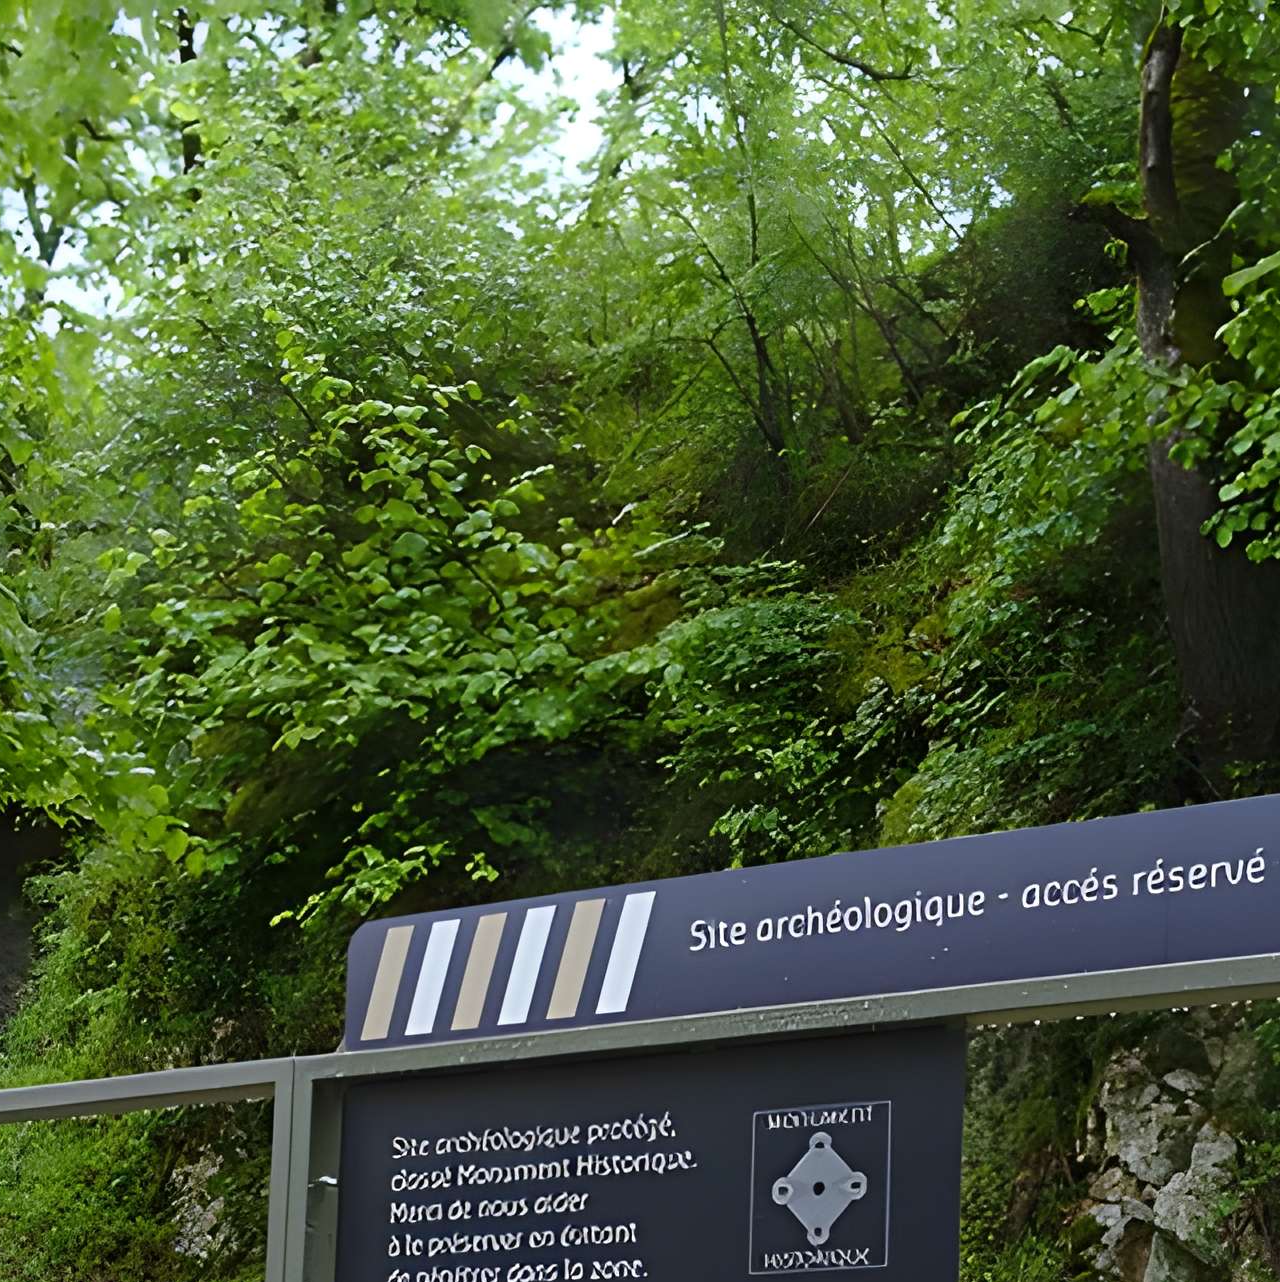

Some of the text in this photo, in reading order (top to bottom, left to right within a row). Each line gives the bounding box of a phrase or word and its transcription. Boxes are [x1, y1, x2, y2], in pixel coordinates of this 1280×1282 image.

[689, 918, 747, 952] Site
[756, 889, 985, 932] archéologique
[1132, 848, 1266, 896] réservé
